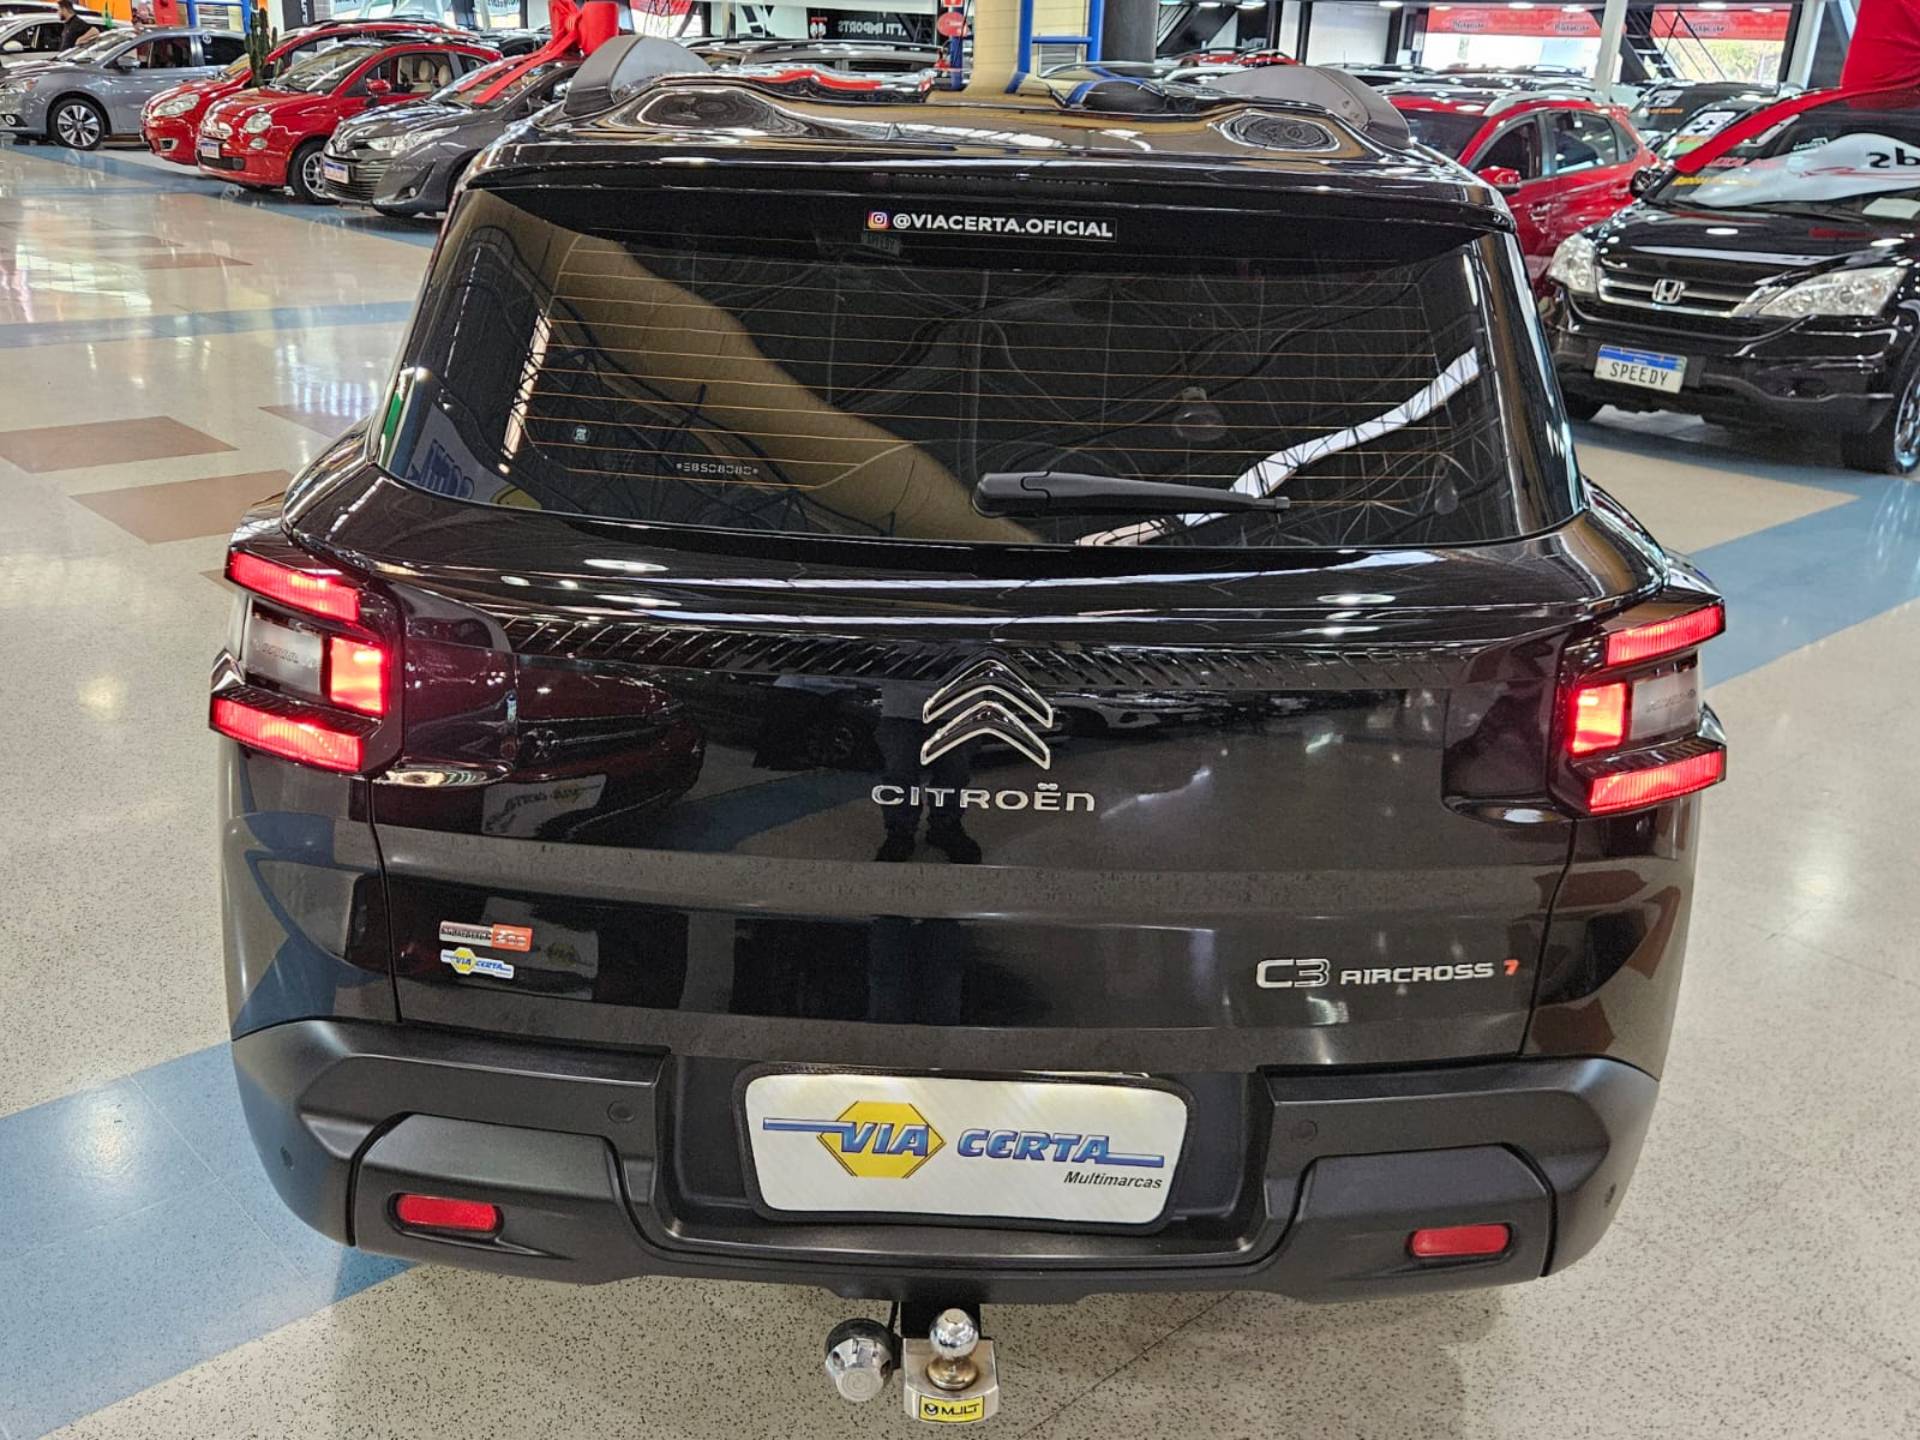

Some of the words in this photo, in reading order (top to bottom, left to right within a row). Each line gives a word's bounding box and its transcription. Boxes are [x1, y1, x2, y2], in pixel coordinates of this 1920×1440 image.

[892, 213, 1113, 238] @VIACERTA.OFICIAL
[1610, 362, 1669, 386] SPEEDY
[1256, 958, 1331, 988] C3
[1340, 962, 1494, 985] AIRCROSS
[1503, 959, 1520, 976] 7
[838, 1122, 931, 1157] VIA
[957, 1129, 1112, 1164] CERTA
[1063, 1170, 1163, 1190] Multimarcas
